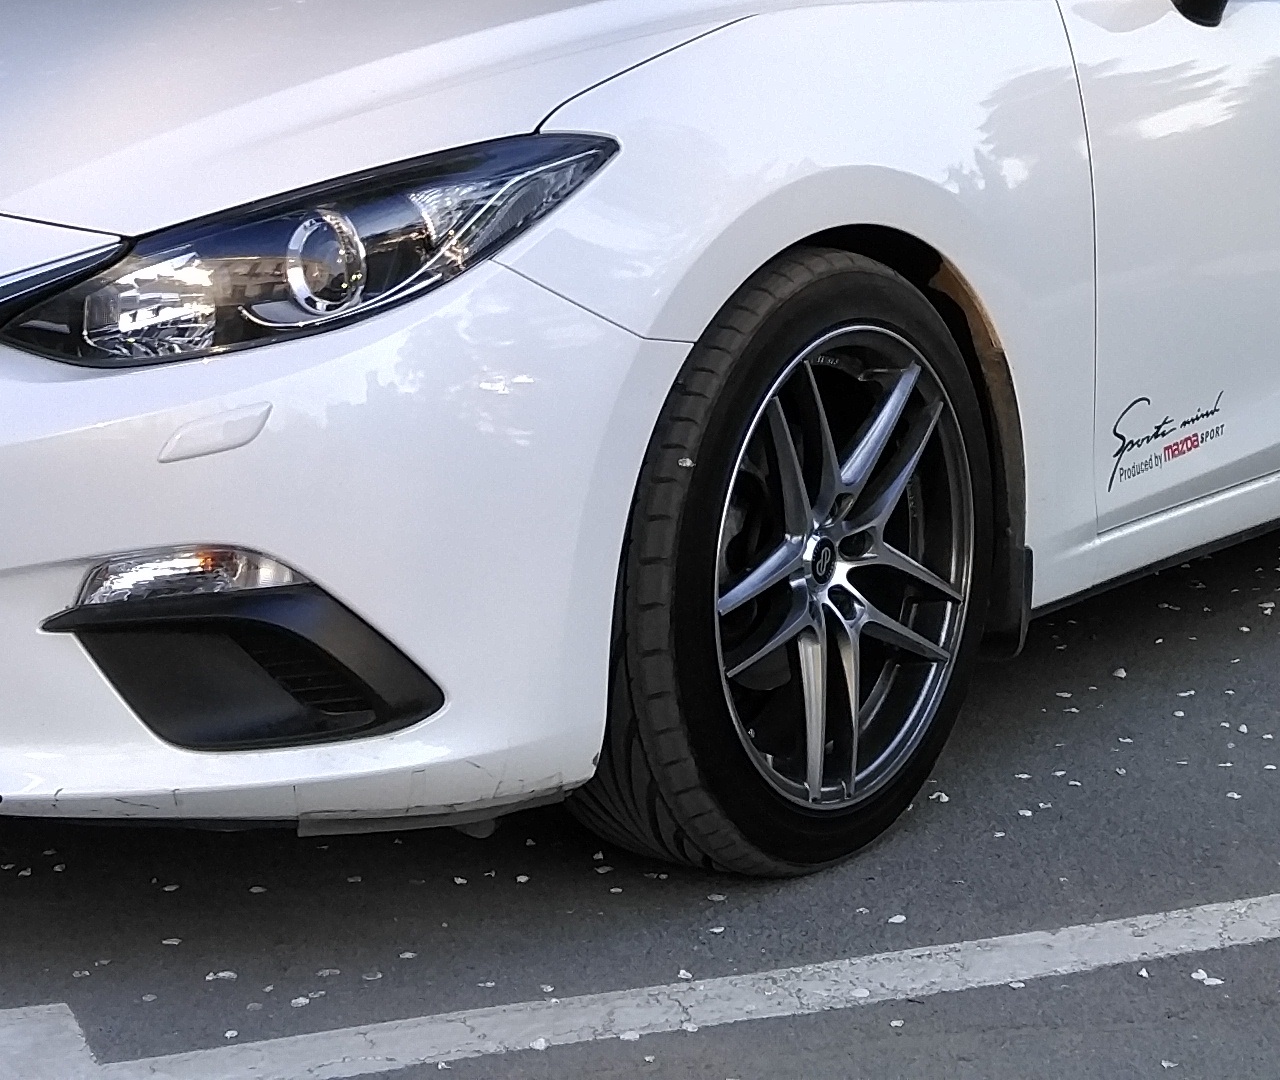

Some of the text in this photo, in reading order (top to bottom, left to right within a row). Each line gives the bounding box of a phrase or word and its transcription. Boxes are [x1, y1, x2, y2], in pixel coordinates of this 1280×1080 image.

[1119, 454, 1153, 483] Produced
[1153, 452, 1163, 470] by
[1200, 424, 1225, 444] SPORT
